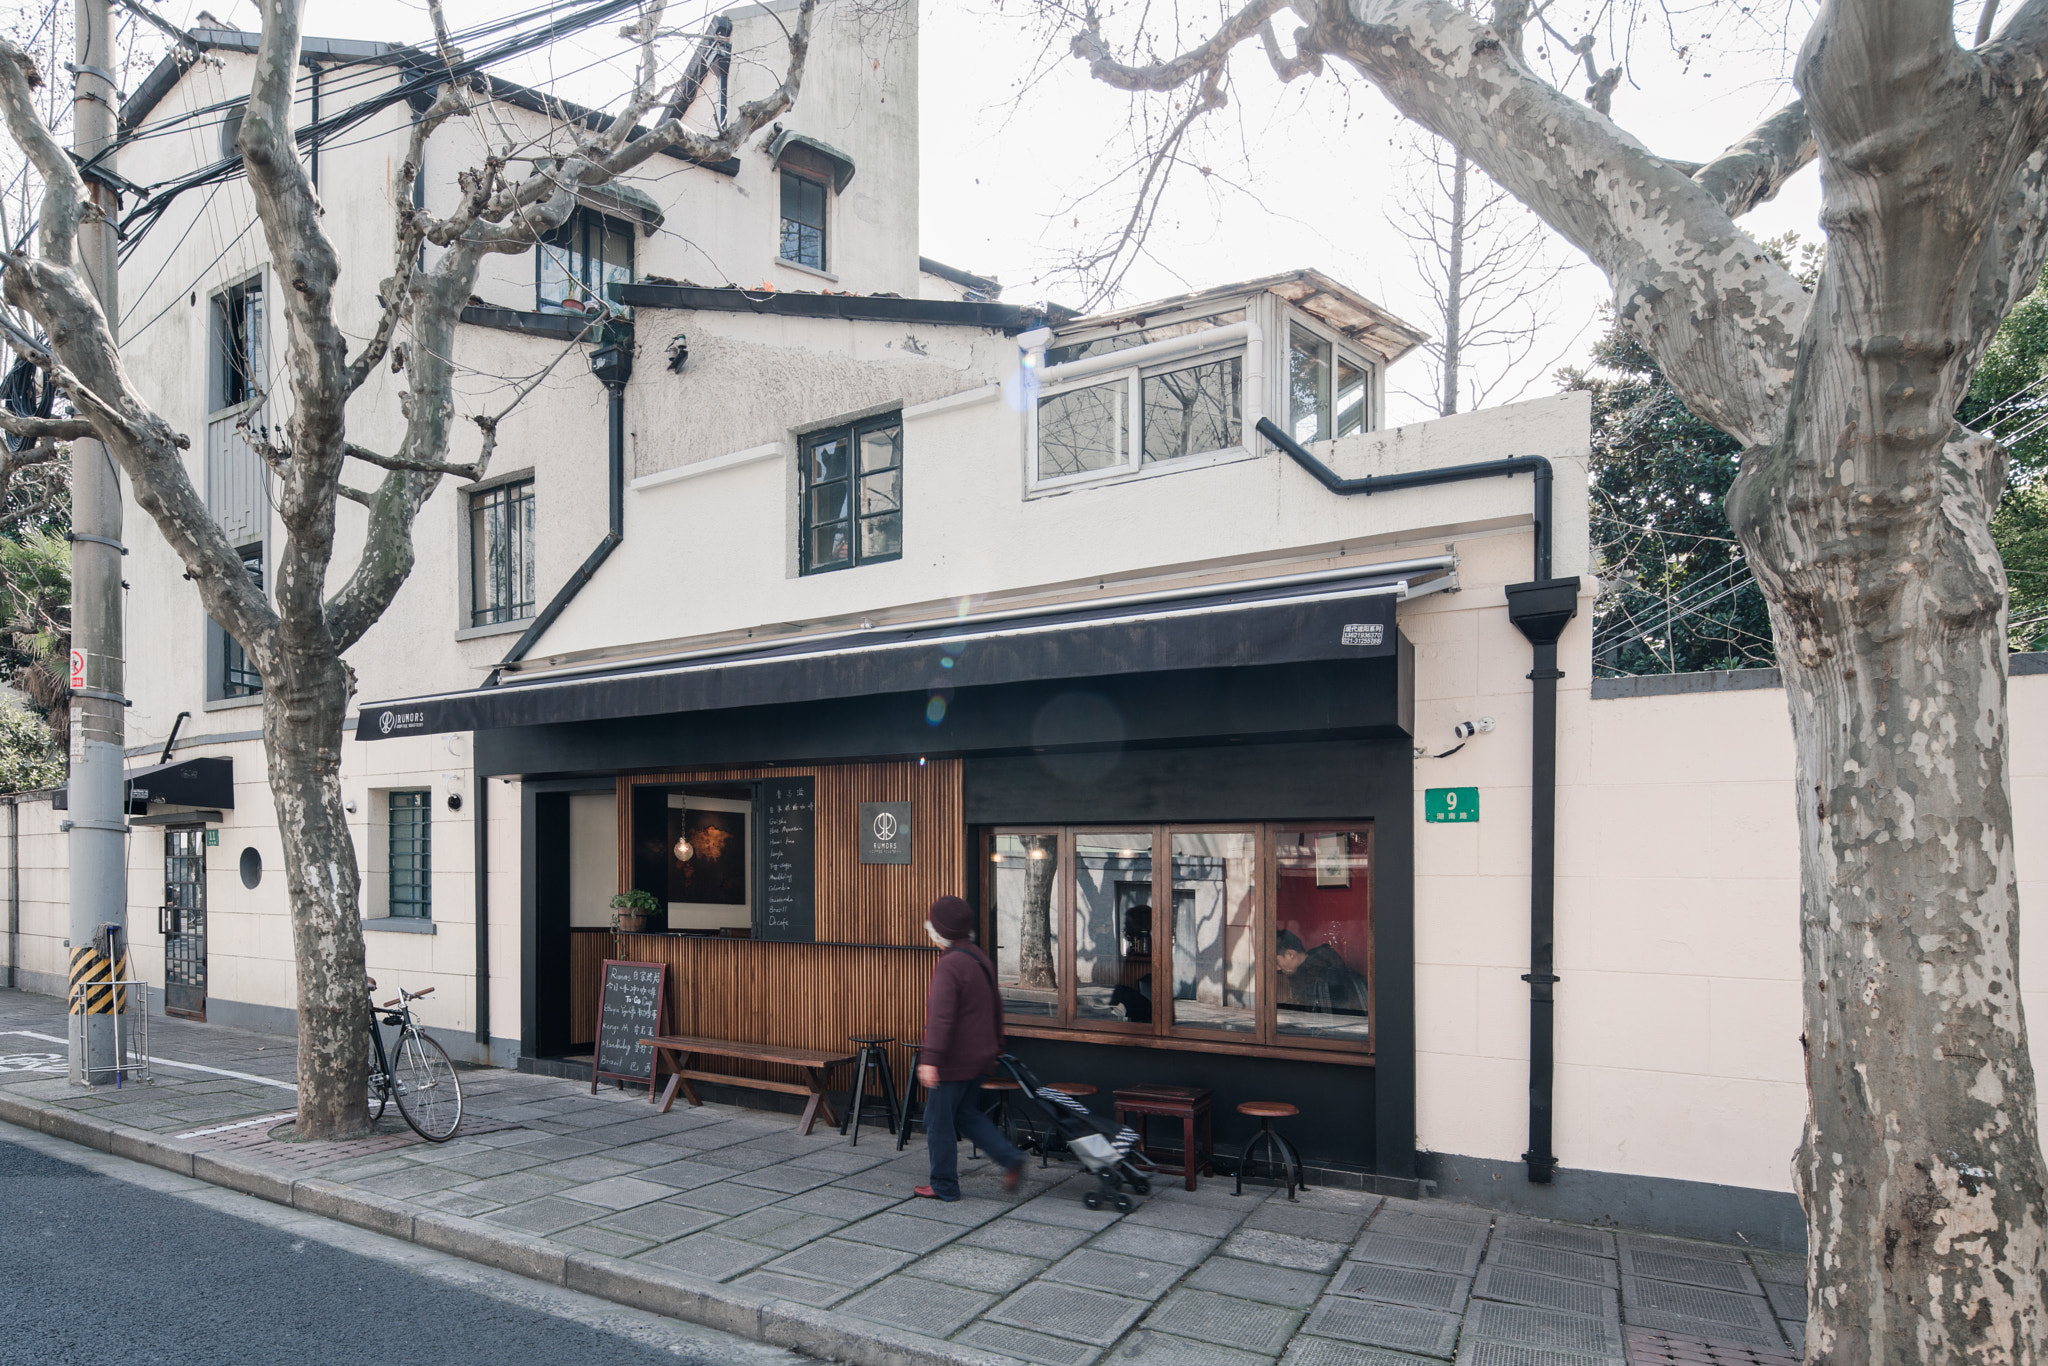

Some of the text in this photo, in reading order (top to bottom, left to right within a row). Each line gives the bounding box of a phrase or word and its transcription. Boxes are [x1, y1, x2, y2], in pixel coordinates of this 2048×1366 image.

[397, 712, 424, 723] RUMORS
[1446, 791, 1457, 811] 9
[209, 831, 216, 841] 11
[610, 967, 631, 982] Rumors
